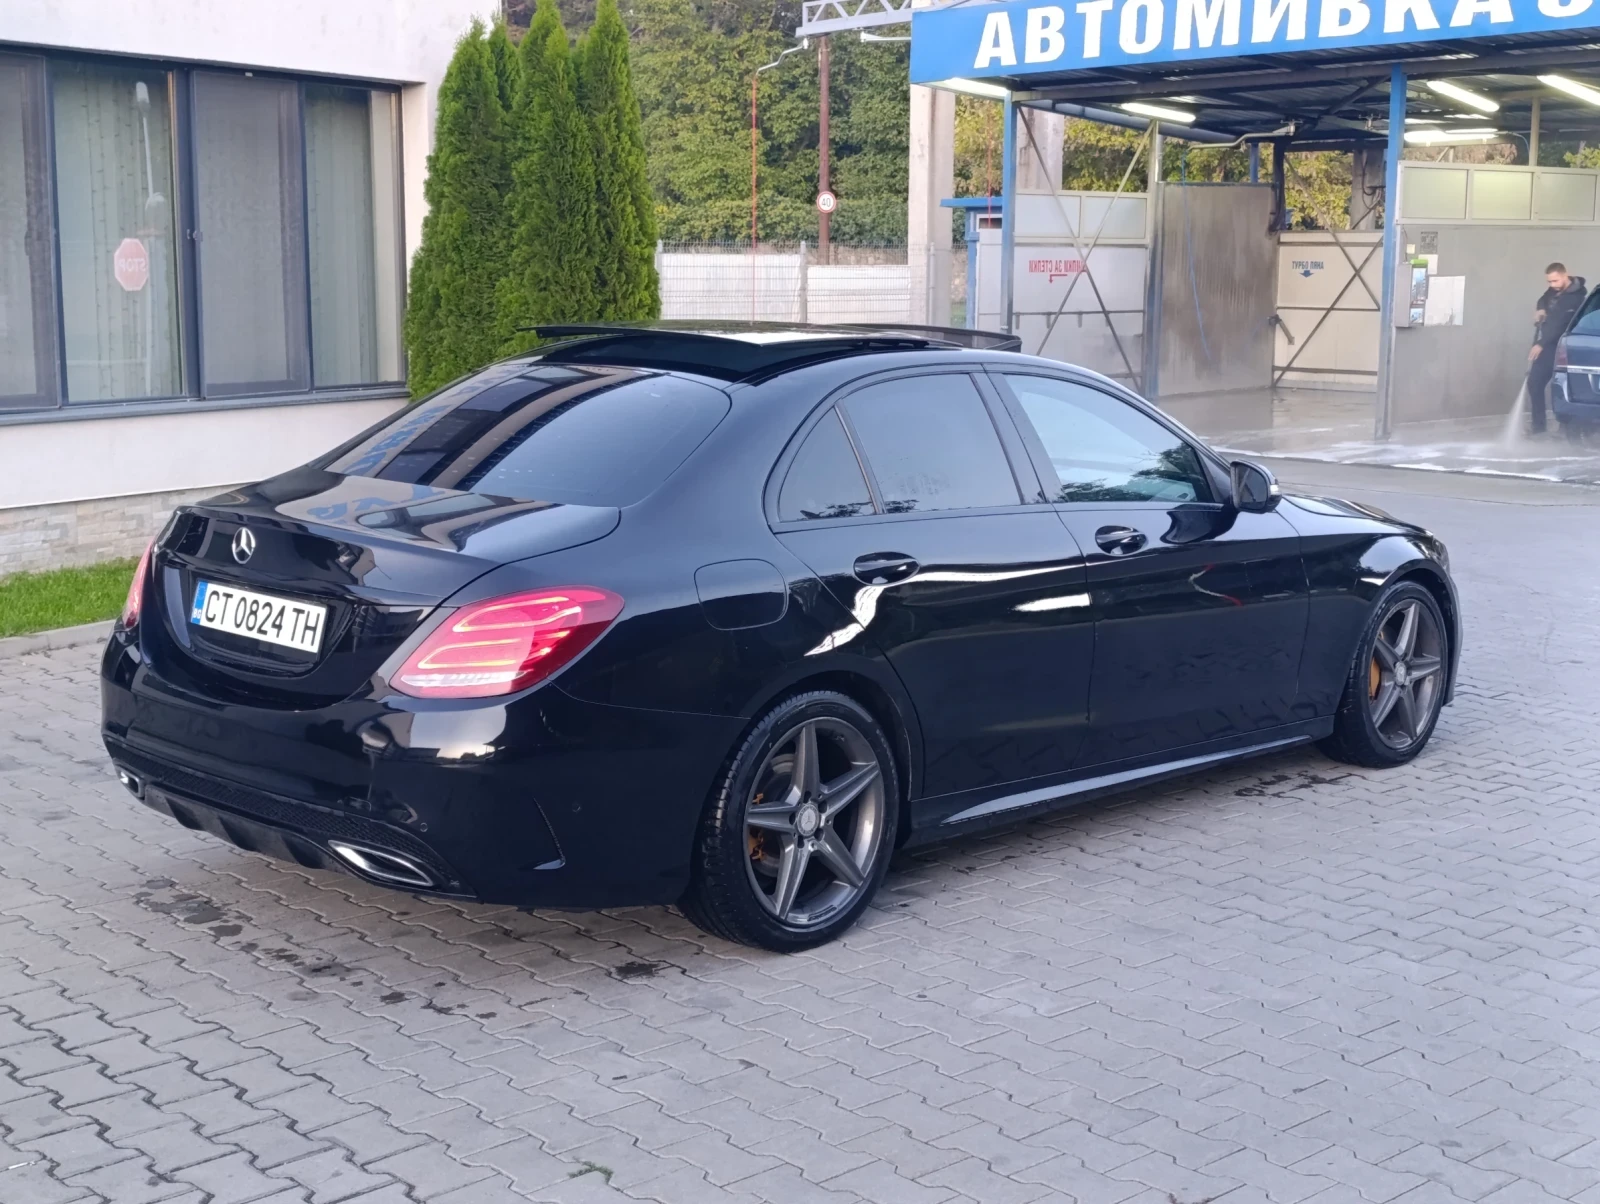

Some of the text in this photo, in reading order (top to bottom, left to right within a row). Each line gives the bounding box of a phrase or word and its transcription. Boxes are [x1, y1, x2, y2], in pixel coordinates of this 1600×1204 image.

[821, 197, 831, 208] 40
[1292, 260, 1309, 270] ТУРБО
[192, 608, 202, 619] BG
[205, 590, 321, 647] CT 0824 TH
